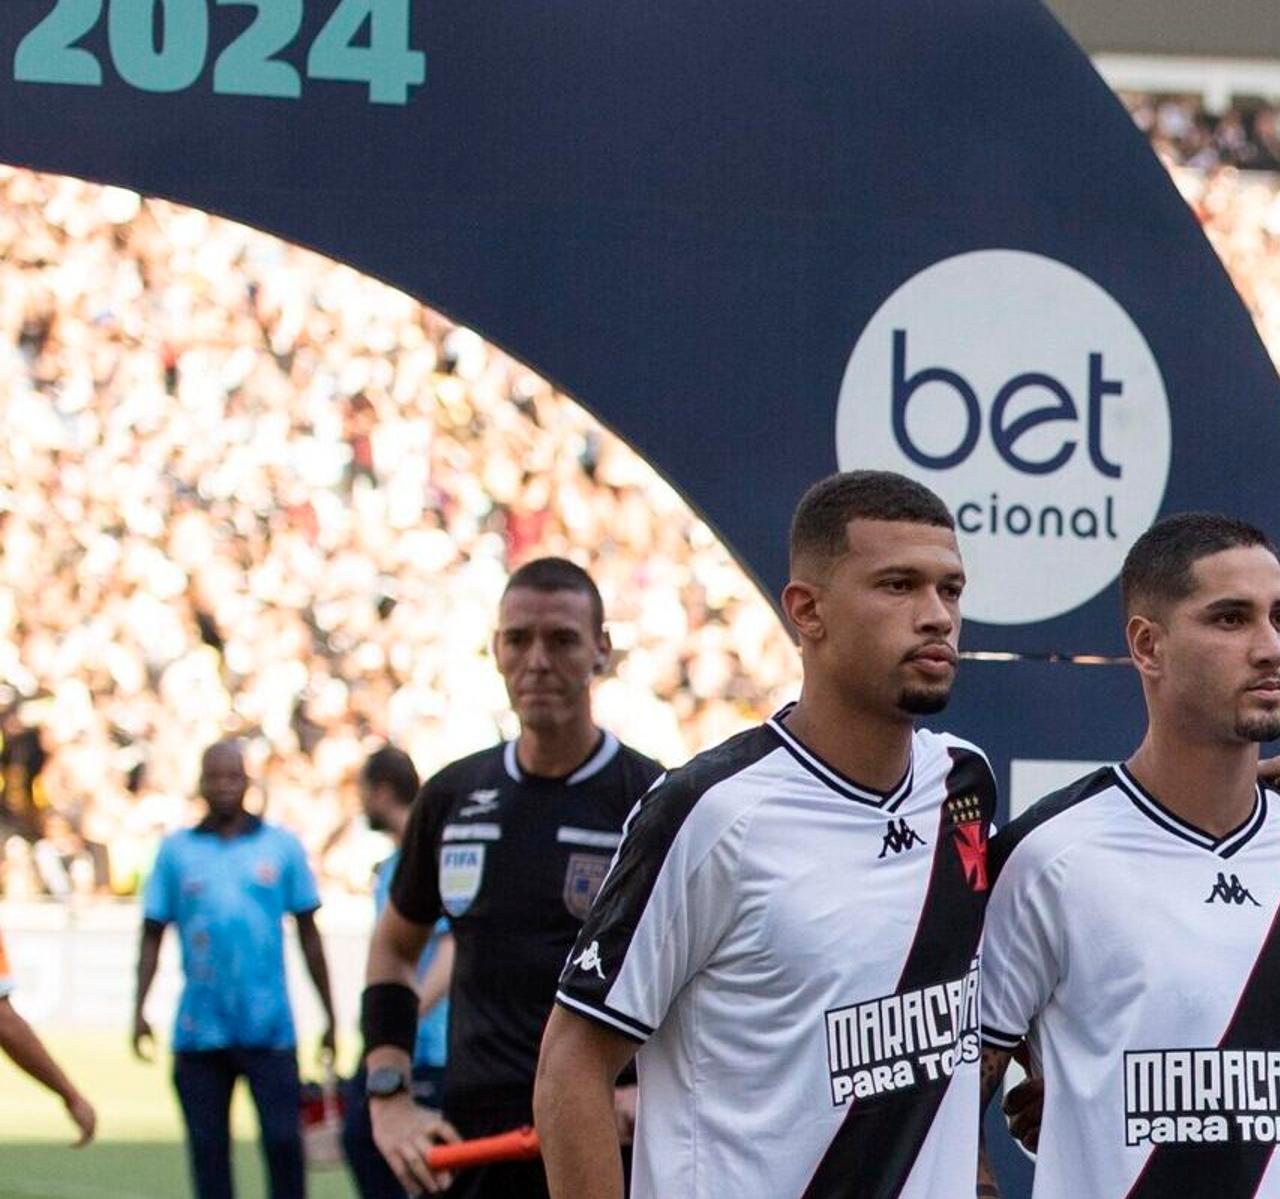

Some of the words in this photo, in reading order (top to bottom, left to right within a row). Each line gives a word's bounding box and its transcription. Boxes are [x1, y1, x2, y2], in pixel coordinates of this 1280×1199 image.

[14, 0, 427, 106] 2024
[892, 329, 1124, 479] bet
[957, 493, 1118, 540] cional
[445, 851, 478, 868] FIFA
